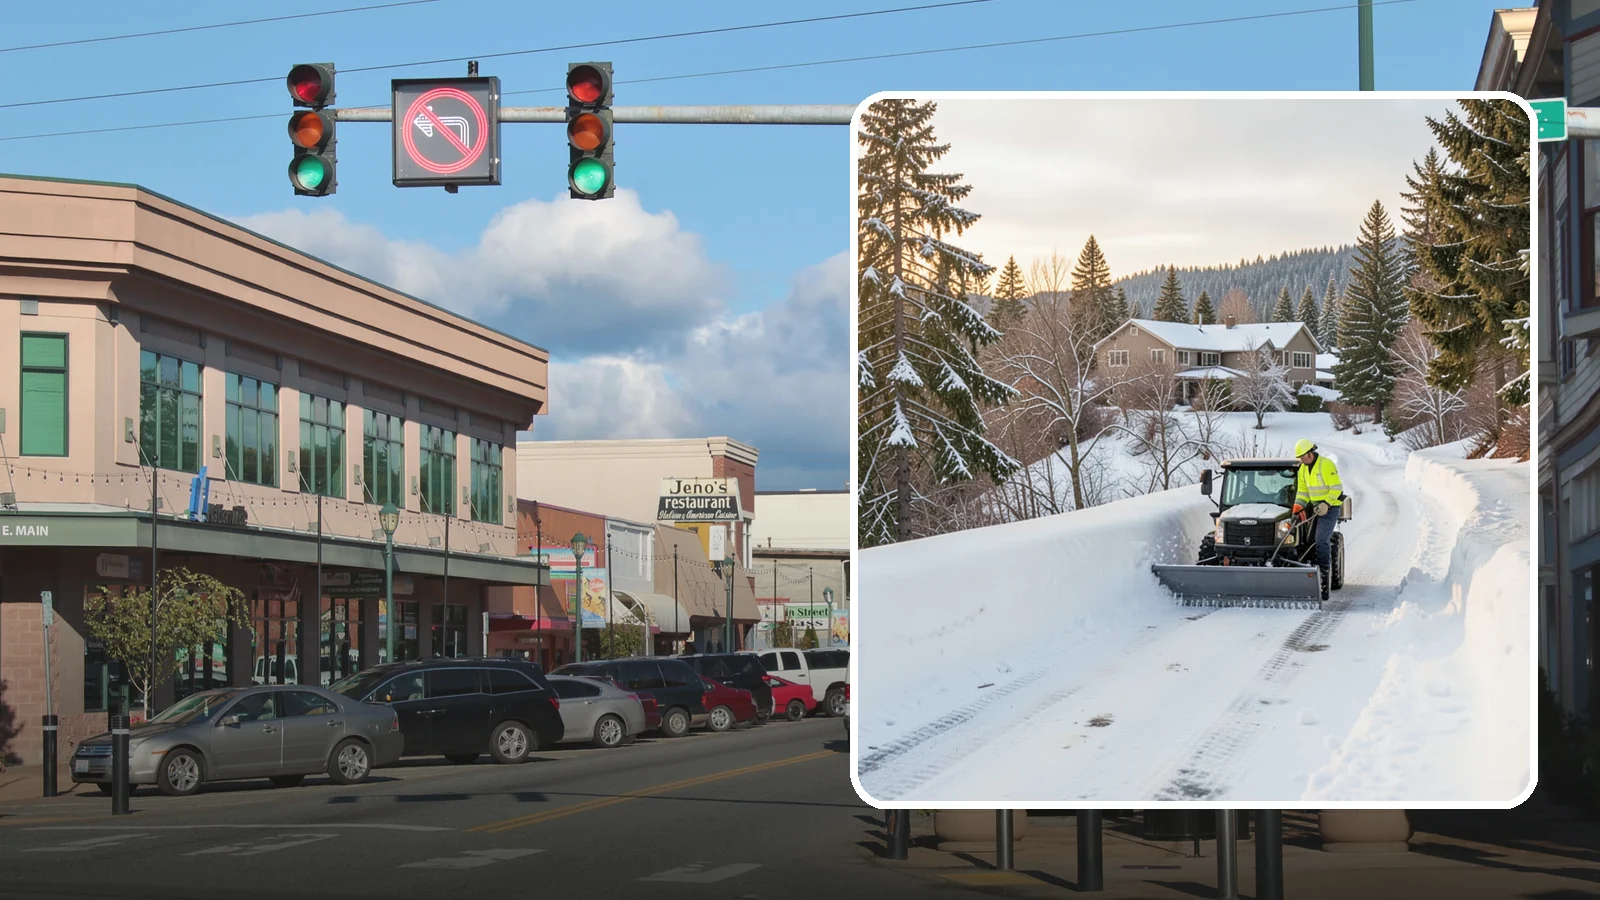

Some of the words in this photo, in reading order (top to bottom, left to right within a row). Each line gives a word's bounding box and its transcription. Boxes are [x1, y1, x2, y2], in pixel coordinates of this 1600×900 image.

[670, 480, 727, 494] Jeno's
[665, 497, 731, 509] restaurant
[659, 510, 681, 520] Italian
[686, 510, 715, 519] American
[715, 509, 738, 519] Cuisine
[2, 525, 13, 536] E.
[15, 525, 49, 536] MAIN
[798, 608, 828, 617] Street
